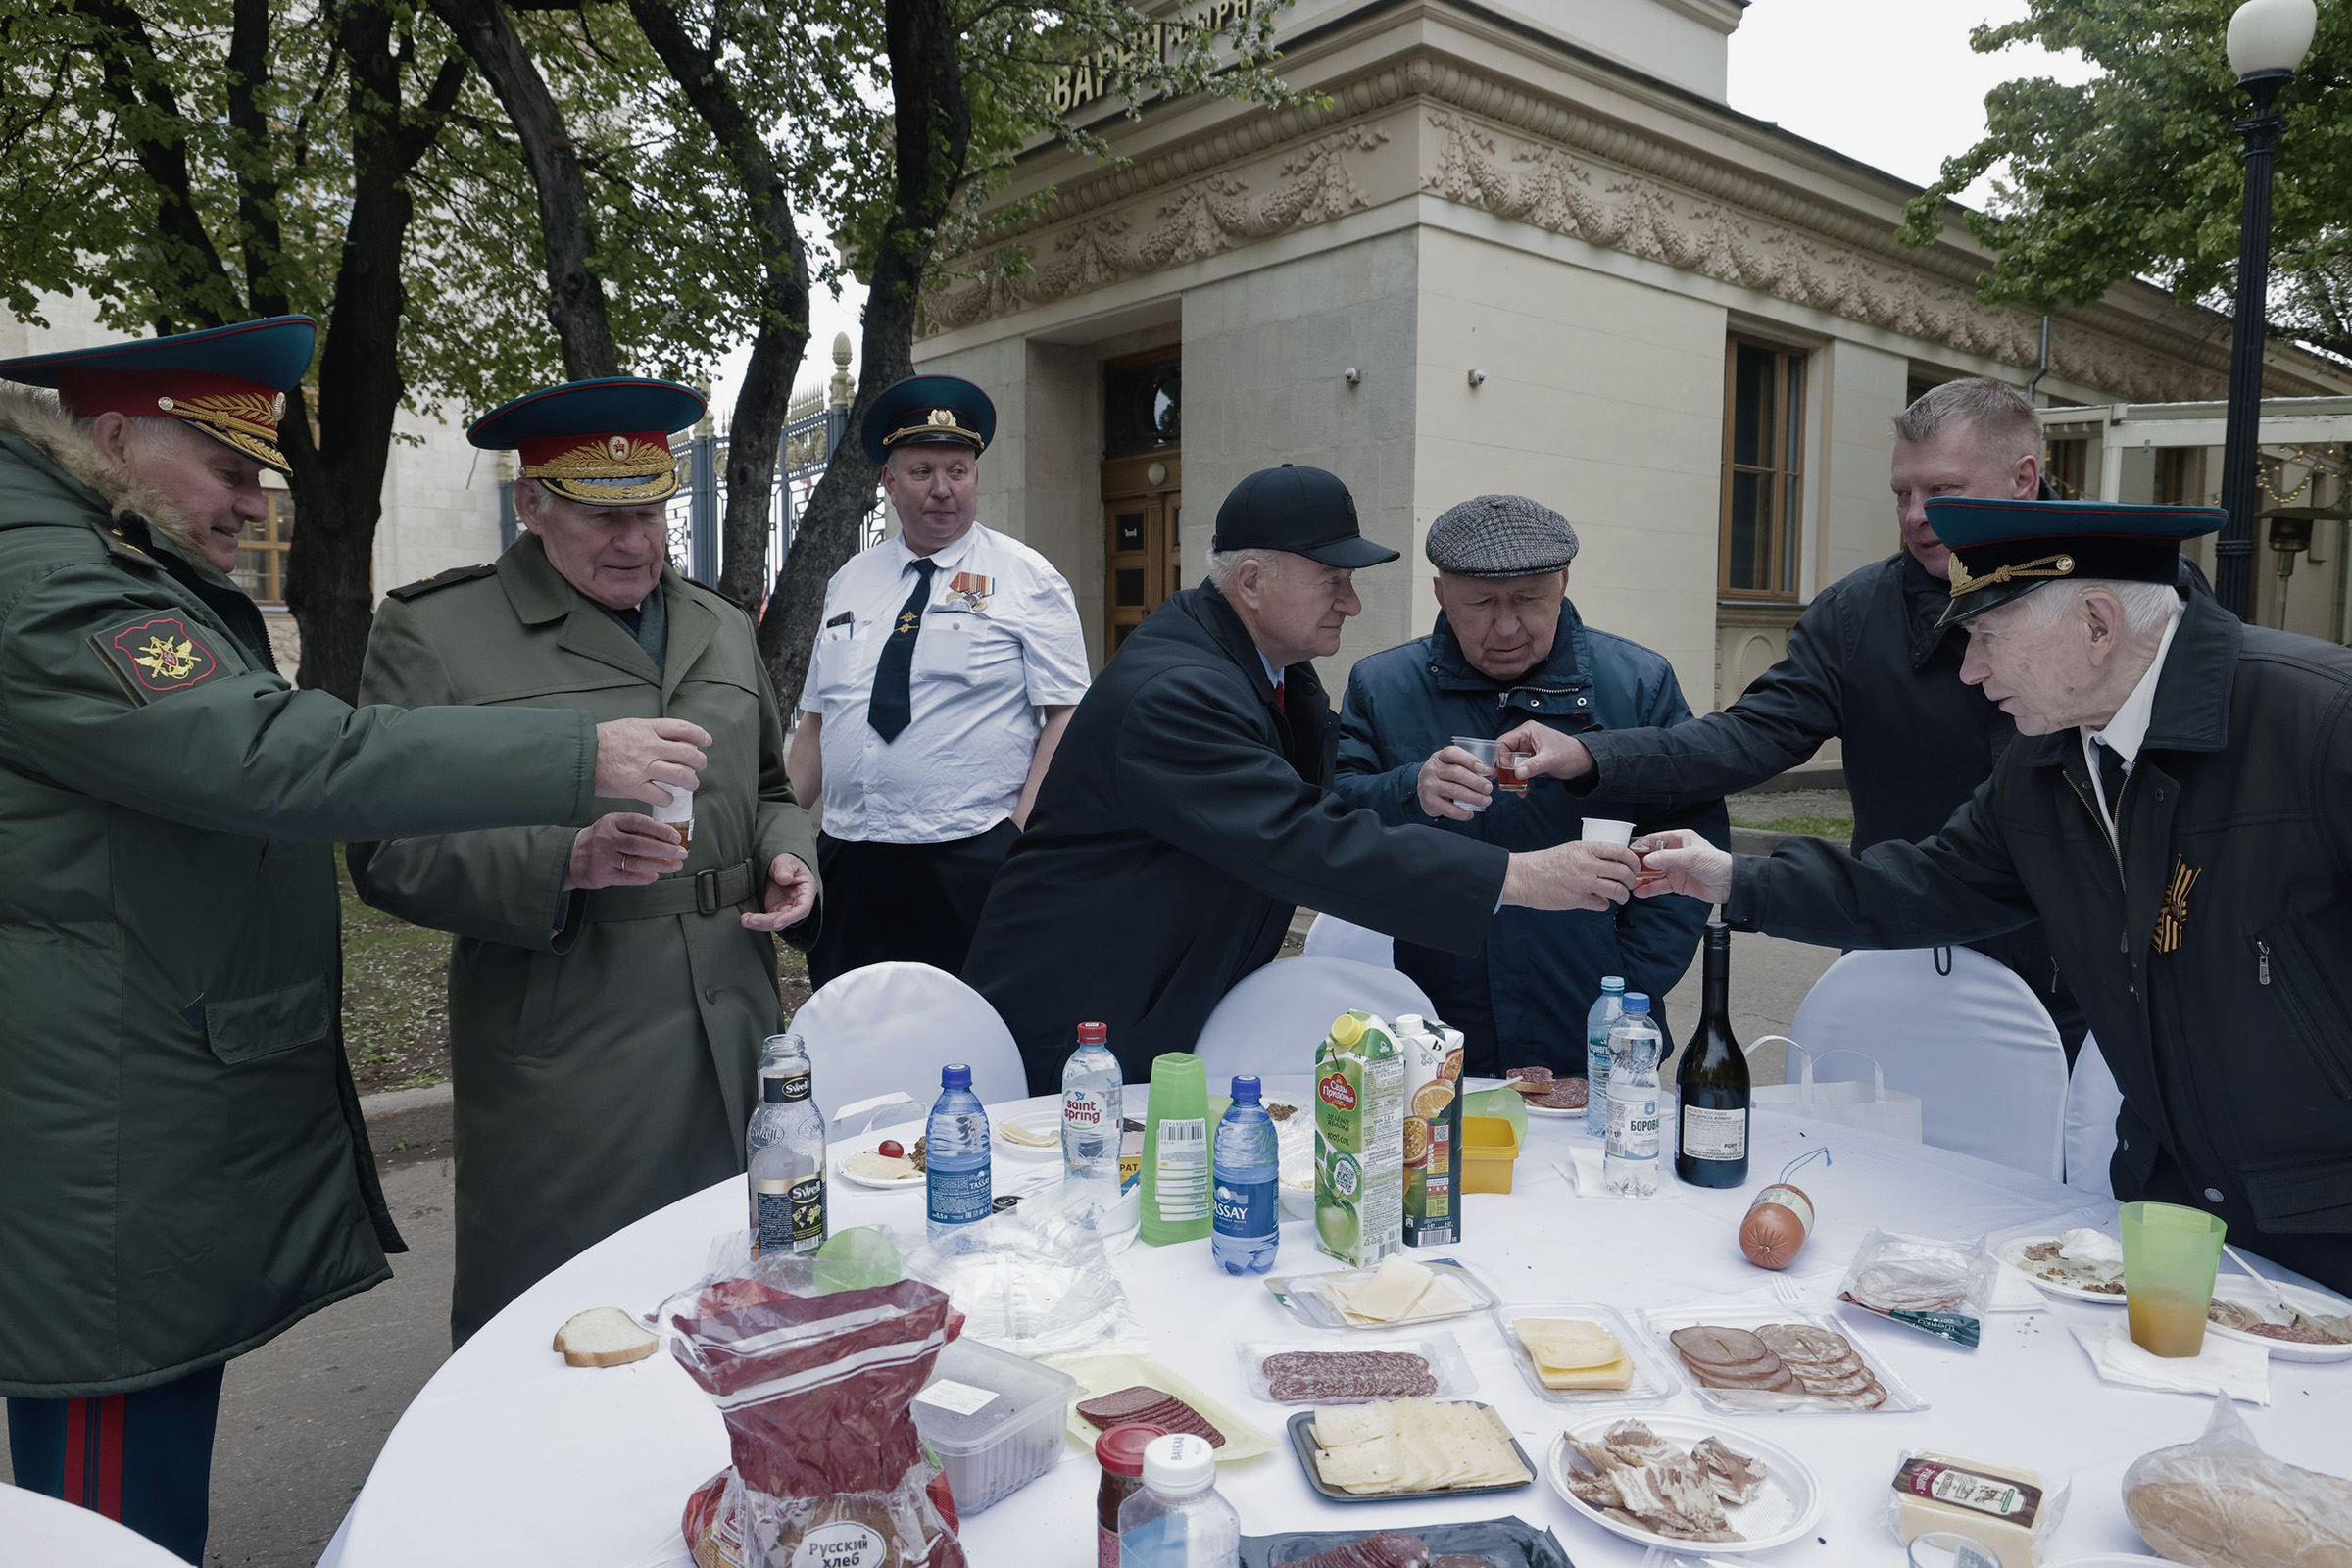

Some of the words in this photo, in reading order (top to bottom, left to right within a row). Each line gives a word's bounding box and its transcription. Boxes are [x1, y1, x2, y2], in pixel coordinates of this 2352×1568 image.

[1322, 1085, 1354, 1104] Придонья
[1330, 1079, 1348, 1094] Сады
[1066, 1100, 1097, 1111] saint
[1064, 1108, 1101, 1124] spring
[969, 1178, 990, 1190] TASSA
[809, 1534, 868, 1558] Русский
[823, 1551, 860, 1568] хлеб
